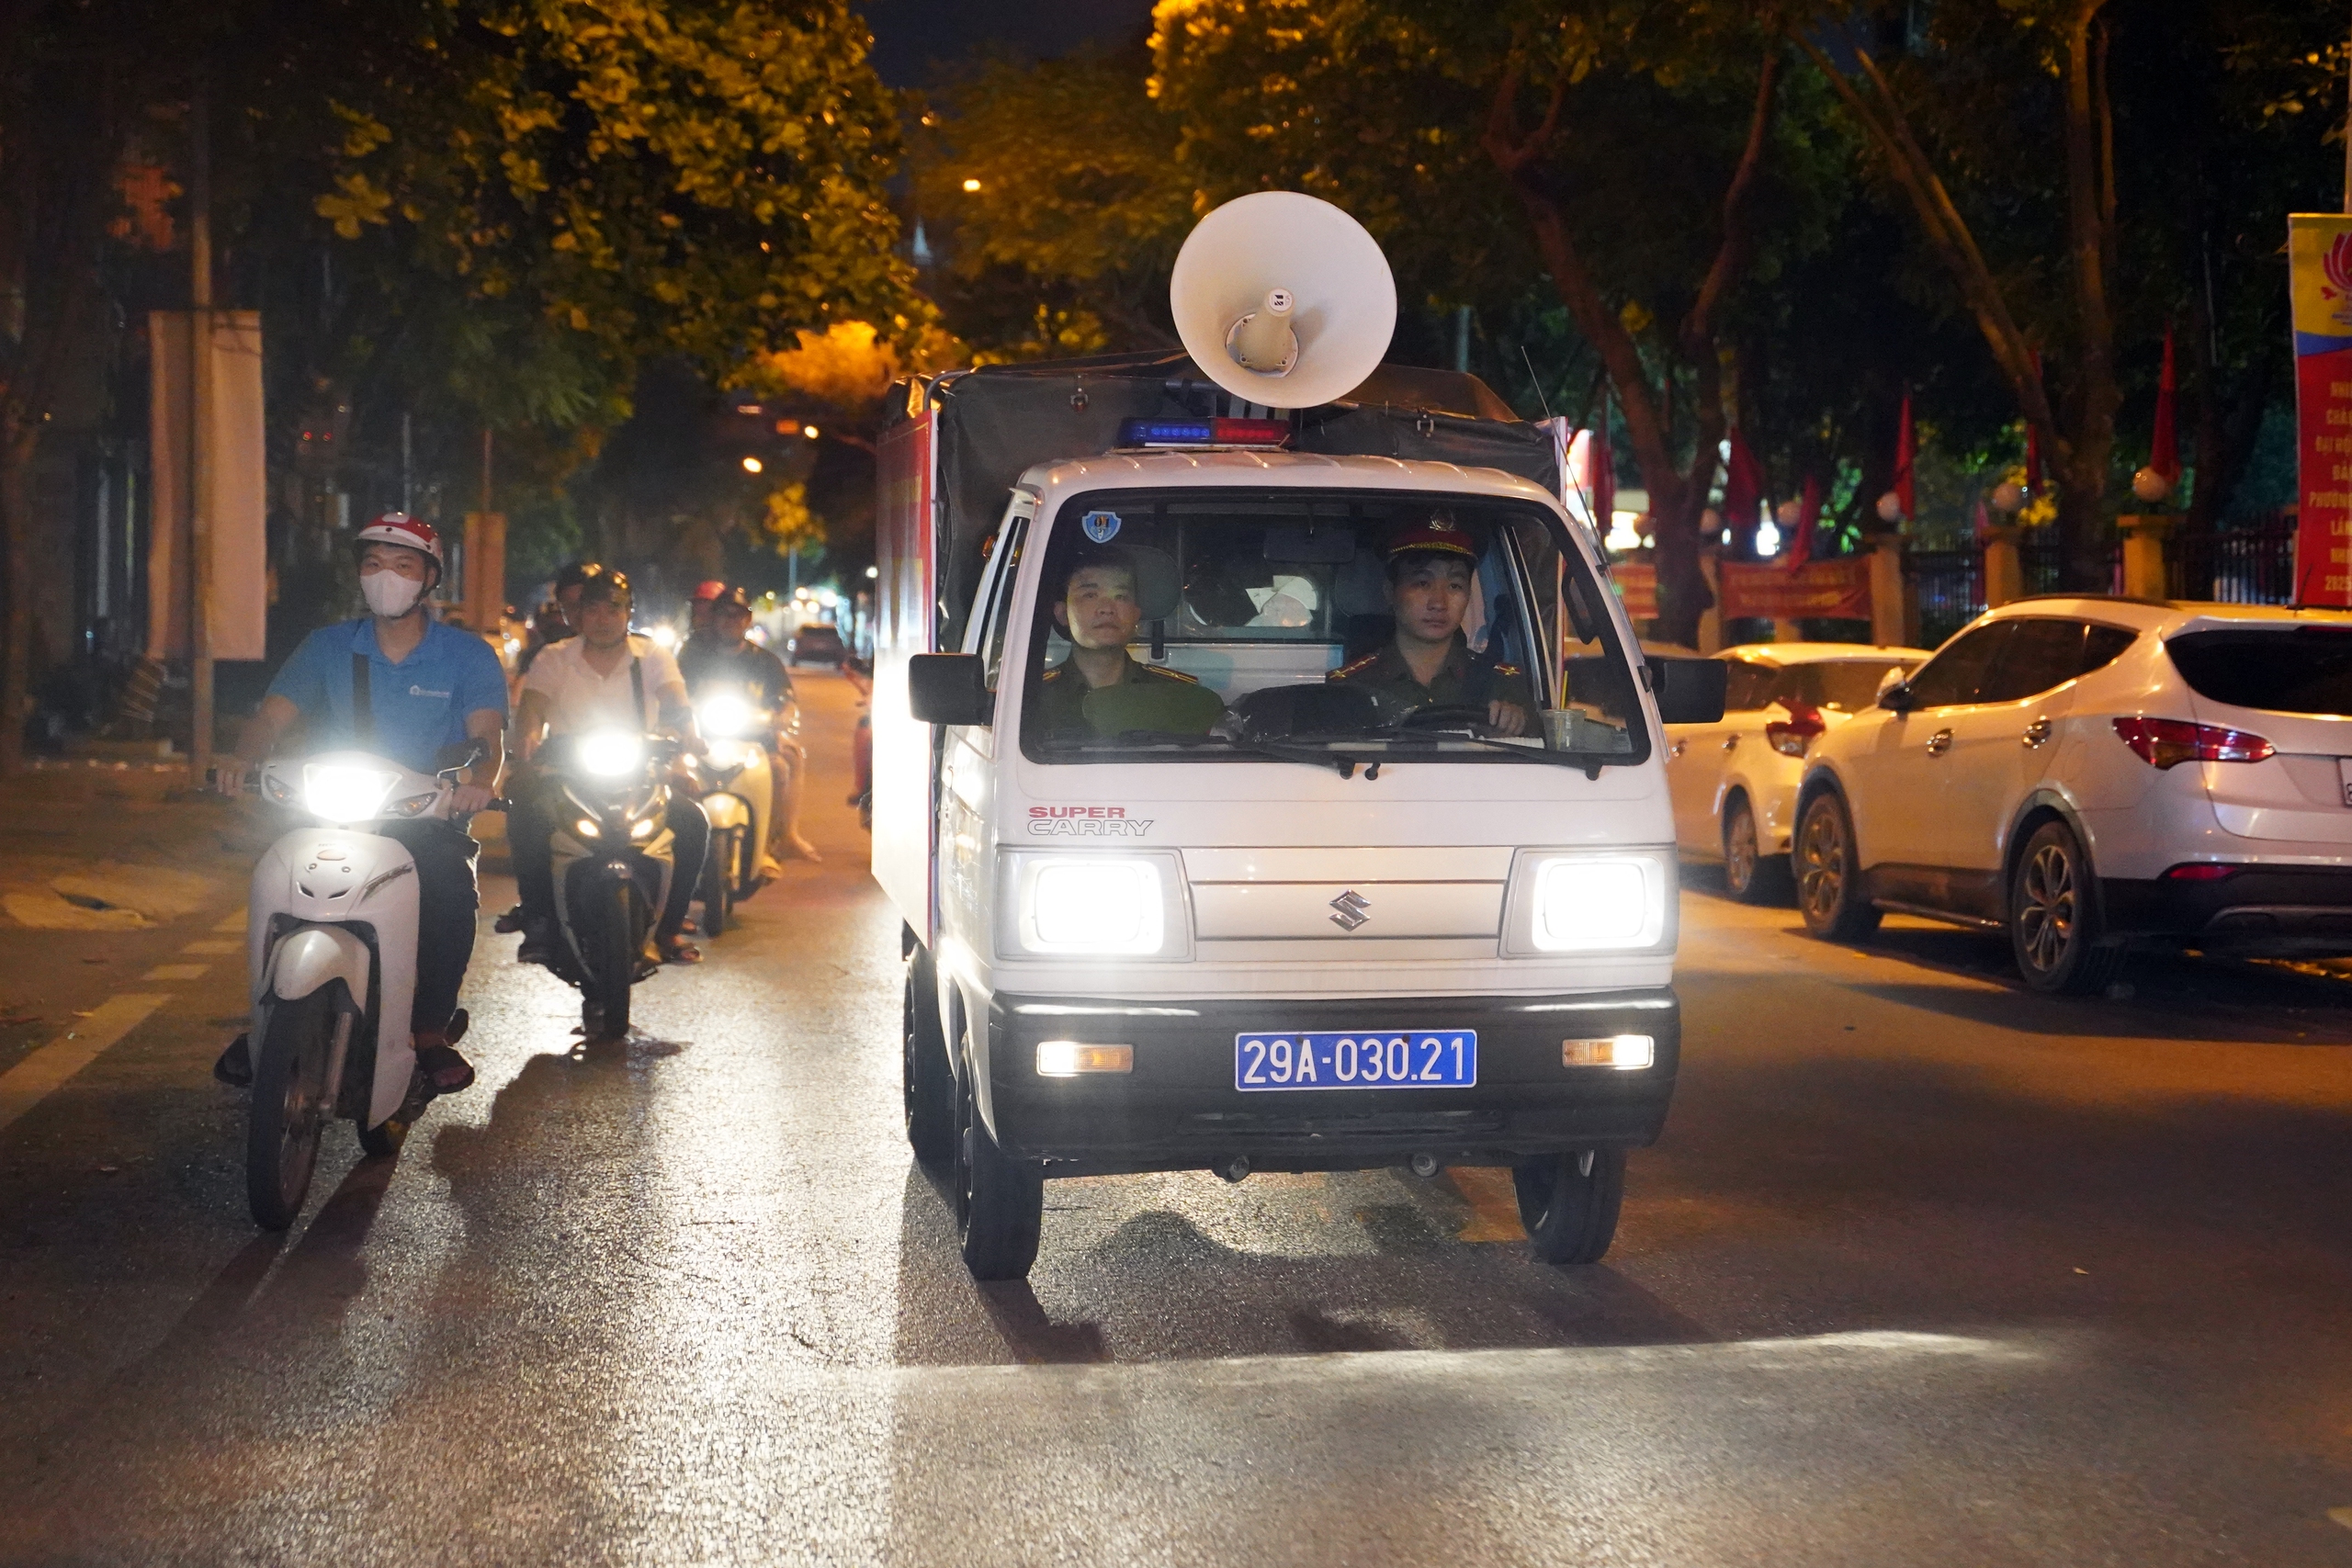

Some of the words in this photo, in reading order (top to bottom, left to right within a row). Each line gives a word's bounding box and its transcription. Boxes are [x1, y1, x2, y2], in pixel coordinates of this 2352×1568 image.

[1028, 806, 1125, 818] SUPER
[1027, 818, 1154, 836] CARRY
[1243, 1037, 1464, 1084] 29A-030.21
